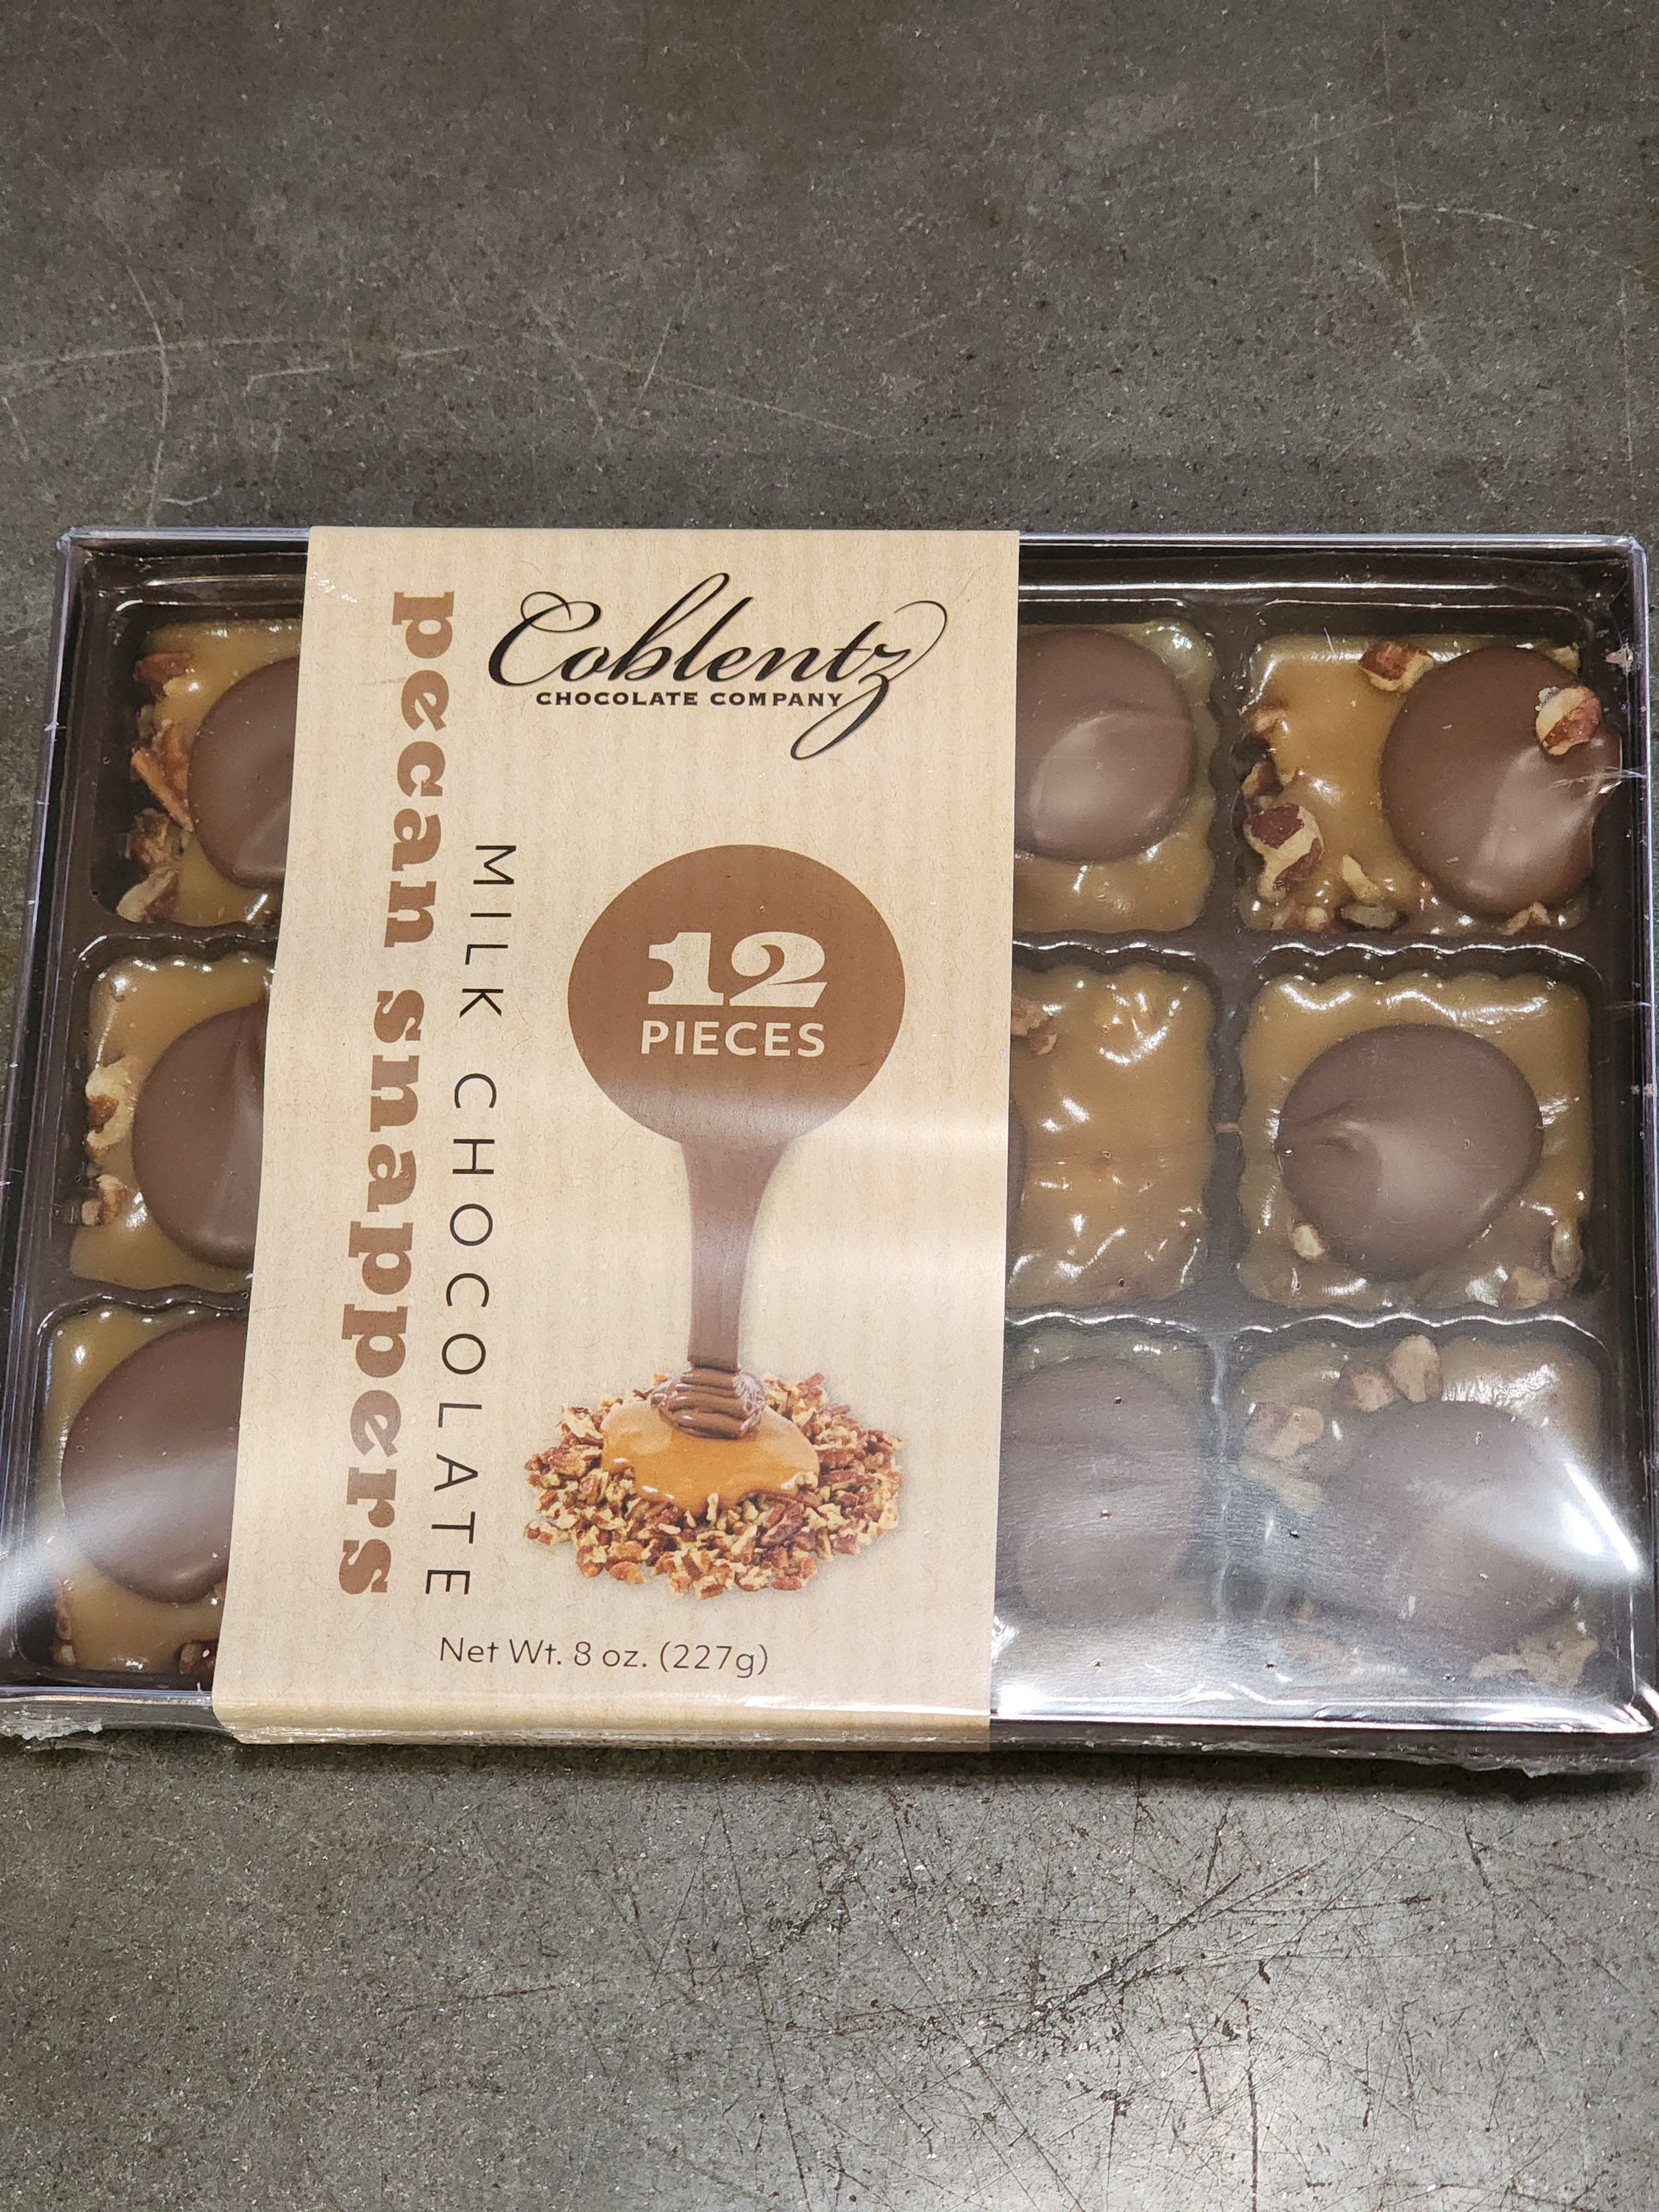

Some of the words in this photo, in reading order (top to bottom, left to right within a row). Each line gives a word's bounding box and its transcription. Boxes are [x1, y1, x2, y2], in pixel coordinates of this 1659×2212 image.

[488, 572, 948, 760] Coblentz
[535, 691, 698, 707] CHOCOLATE
[709, 692, 843, 707] COMPANY
[384, 591, 455, 948] pecan
[459, 845, 517, 1018] MILK
[648, 931, 828, 1008] 12
[640, 1020, 825, 1057] PIECES
[338, 989, 425, 1596] snappers
[425, 1073, 497, 1595] CHOCOLATE
[440, 1636, 499, 1663] Net
[509, 1639, 562, 1666] Wt.
[573, 1641, 591, 1666] 8
[602, 1648, 648, 1668] oz.
[659, 1641, 769, 1678] (227g)
